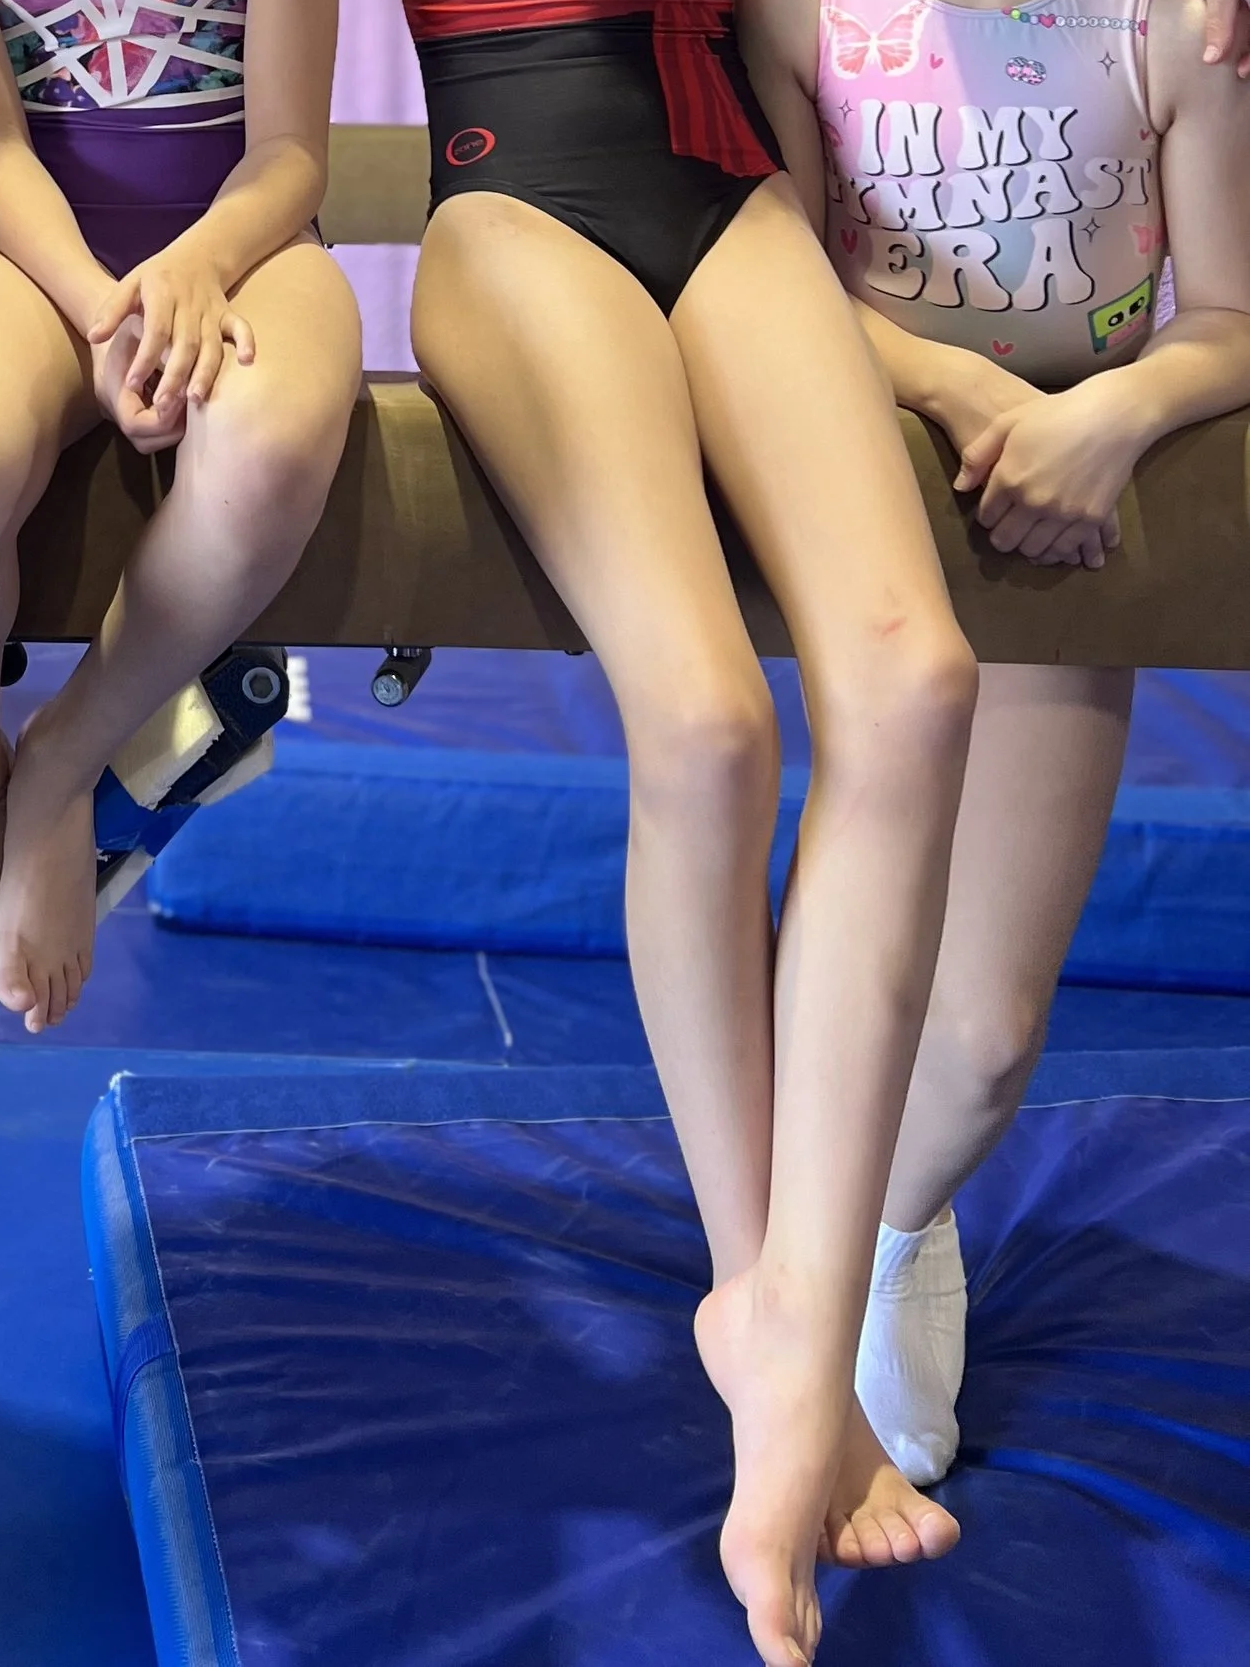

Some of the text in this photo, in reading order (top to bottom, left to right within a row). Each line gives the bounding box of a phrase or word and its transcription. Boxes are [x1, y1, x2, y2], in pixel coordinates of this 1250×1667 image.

[858, 99, 1078, 176] IN MY
[864, 218, 1095, 312] ERA
